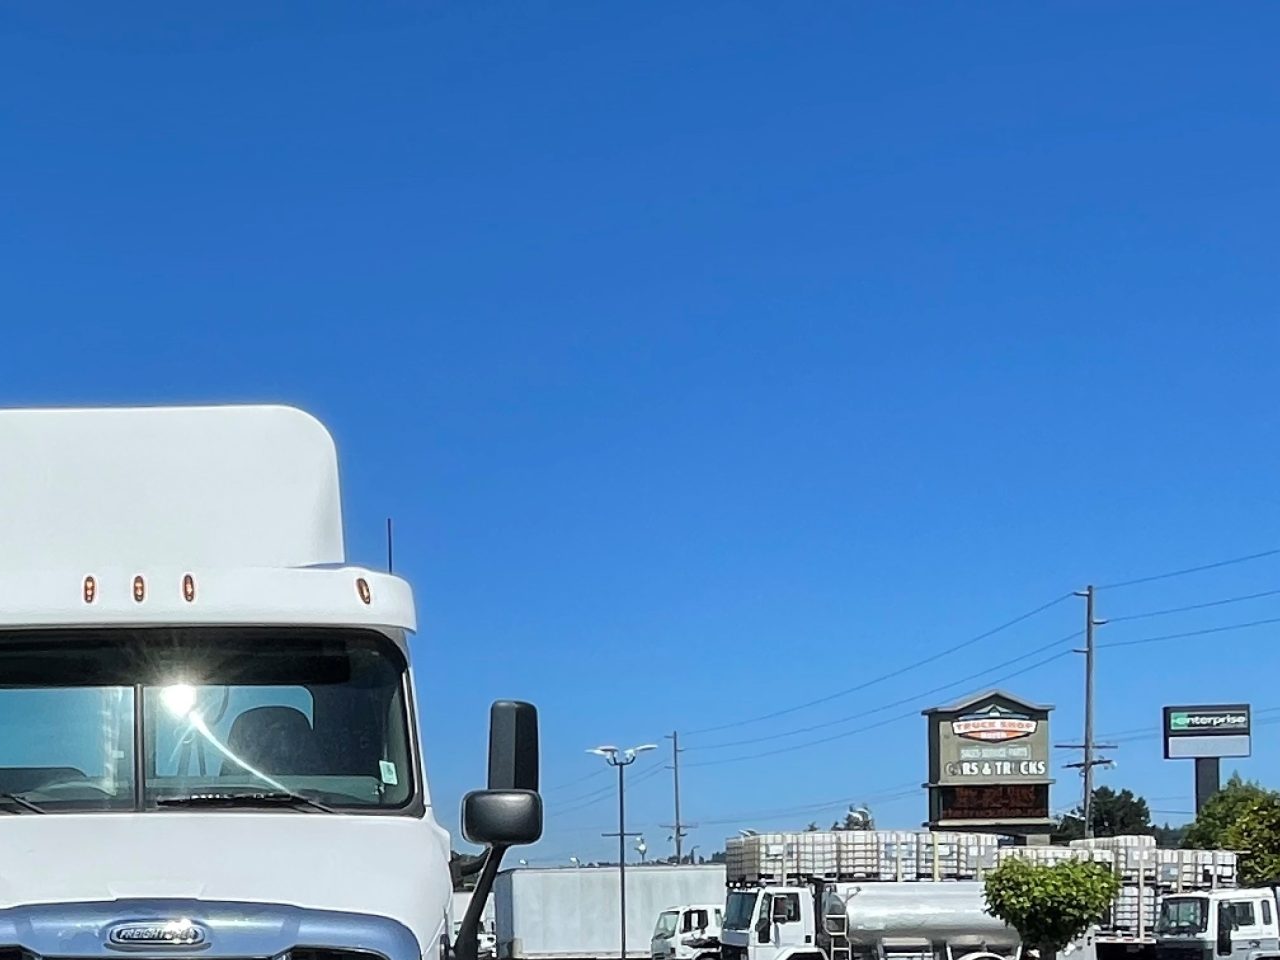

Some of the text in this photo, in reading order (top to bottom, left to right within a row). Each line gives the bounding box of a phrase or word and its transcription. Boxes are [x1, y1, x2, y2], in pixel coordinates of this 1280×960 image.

[956, 721, 1033, 730] TRUCK SHOP
[1174, 714, 1246, 726] enterprise
[981, 762, 992, 775] &
[120, 928, 195, 939] FREIGHTER
